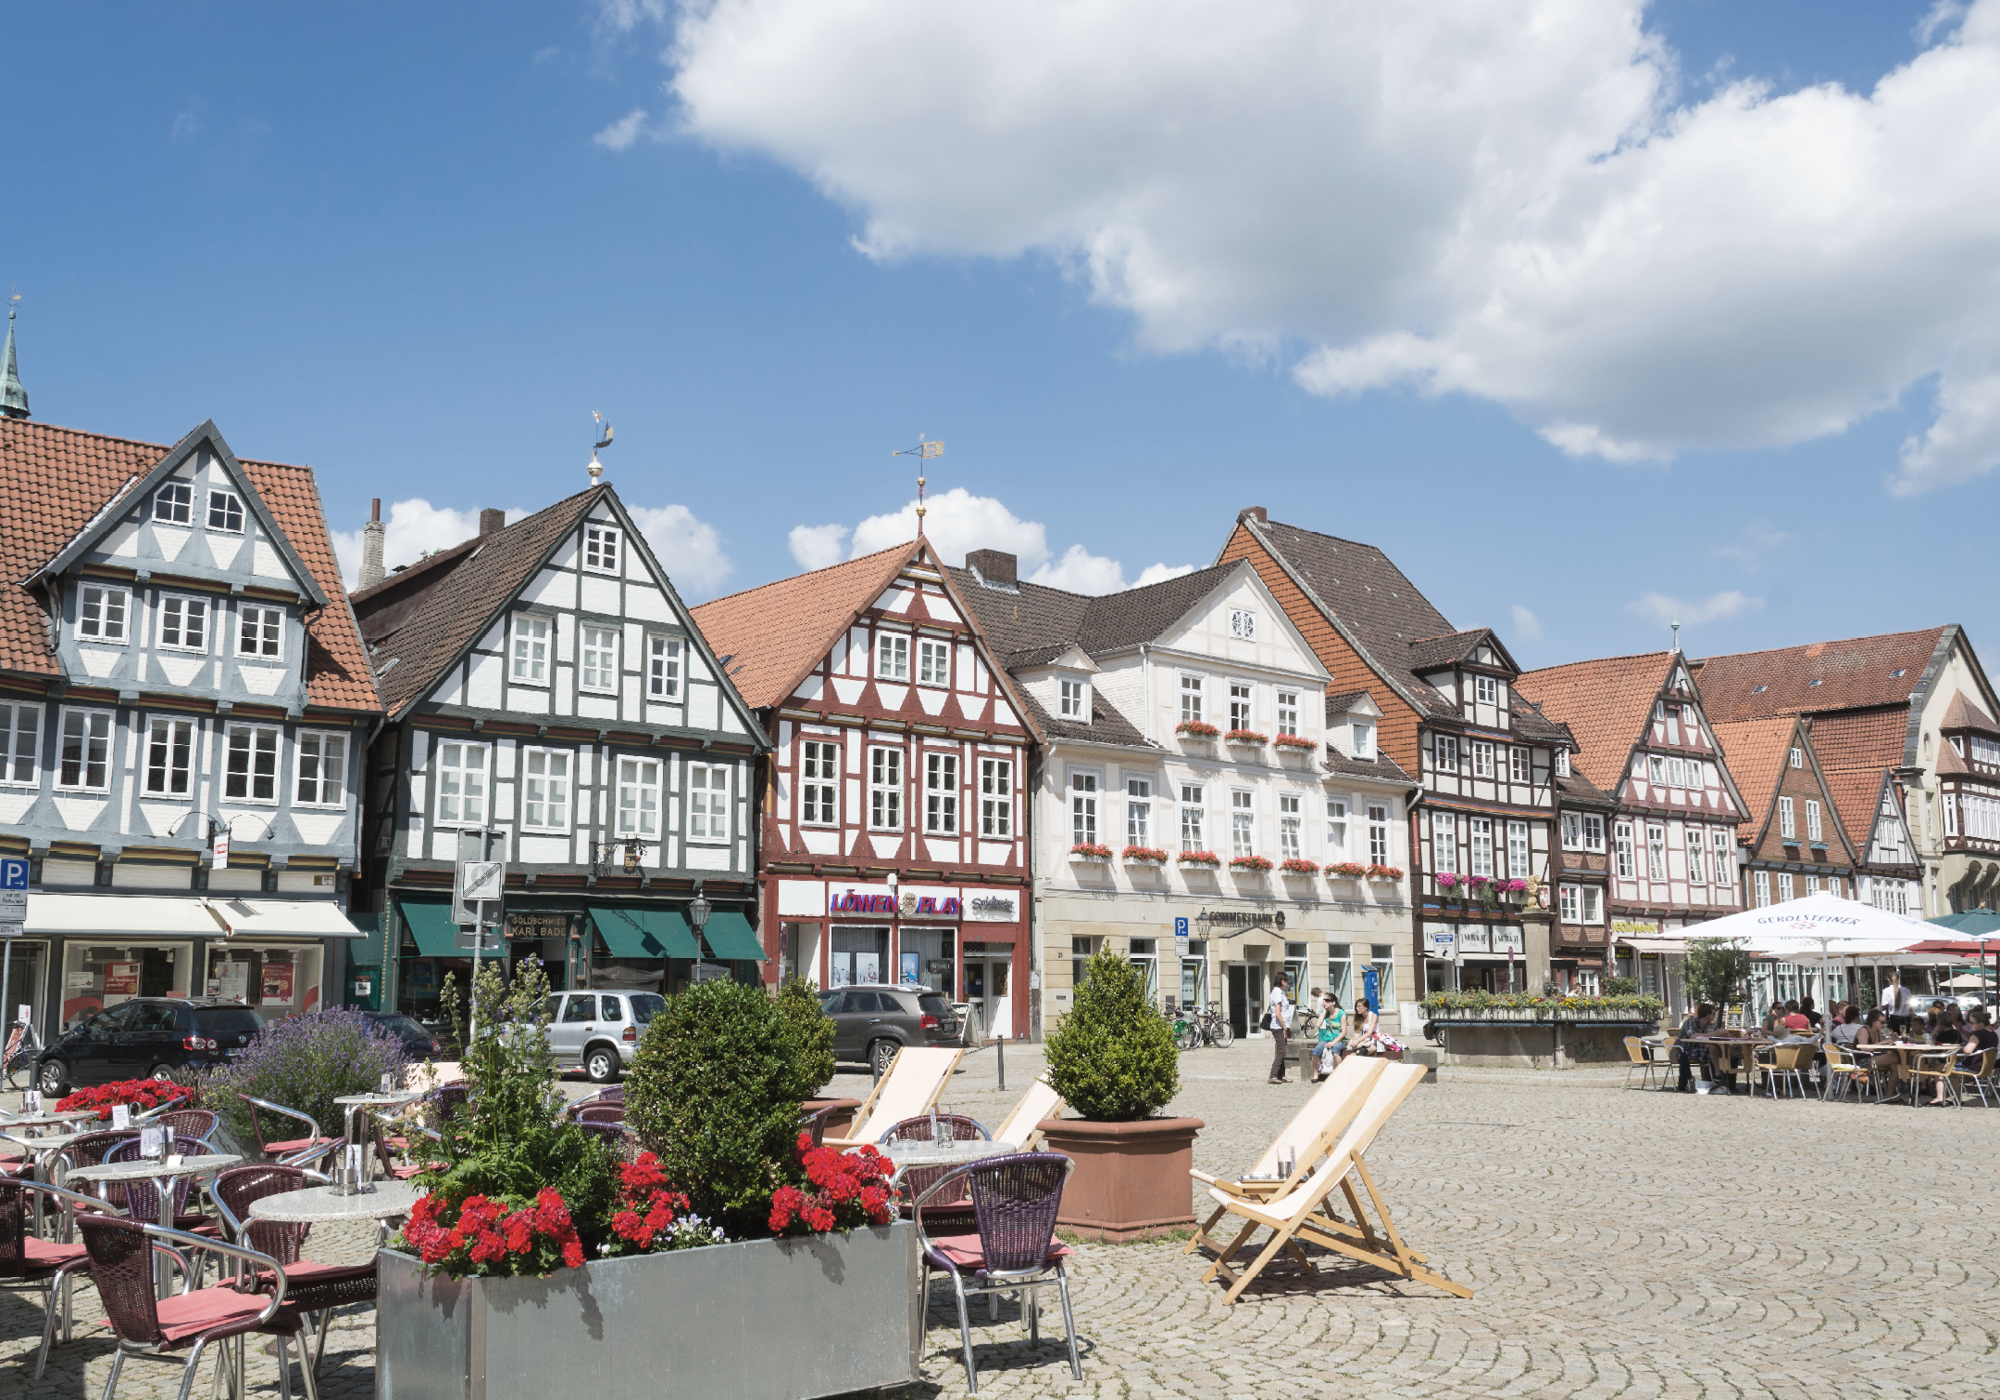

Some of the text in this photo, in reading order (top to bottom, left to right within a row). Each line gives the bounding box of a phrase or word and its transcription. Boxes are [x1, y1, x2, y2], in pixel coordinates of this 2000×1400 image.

[6, 863, 23, 886] P
[830, 889, 964, 915] LÖWEN PLAY
[512, 916, 567, 926] GOLDSCHMIED
[1209, 911, 1273, 923] COMMERZBANK
[1757, 914, 1861, 926] GEROLSTEINER
[512, 927, 567, 937] KARL BADE
[1177, 919, 1186, 934] P
